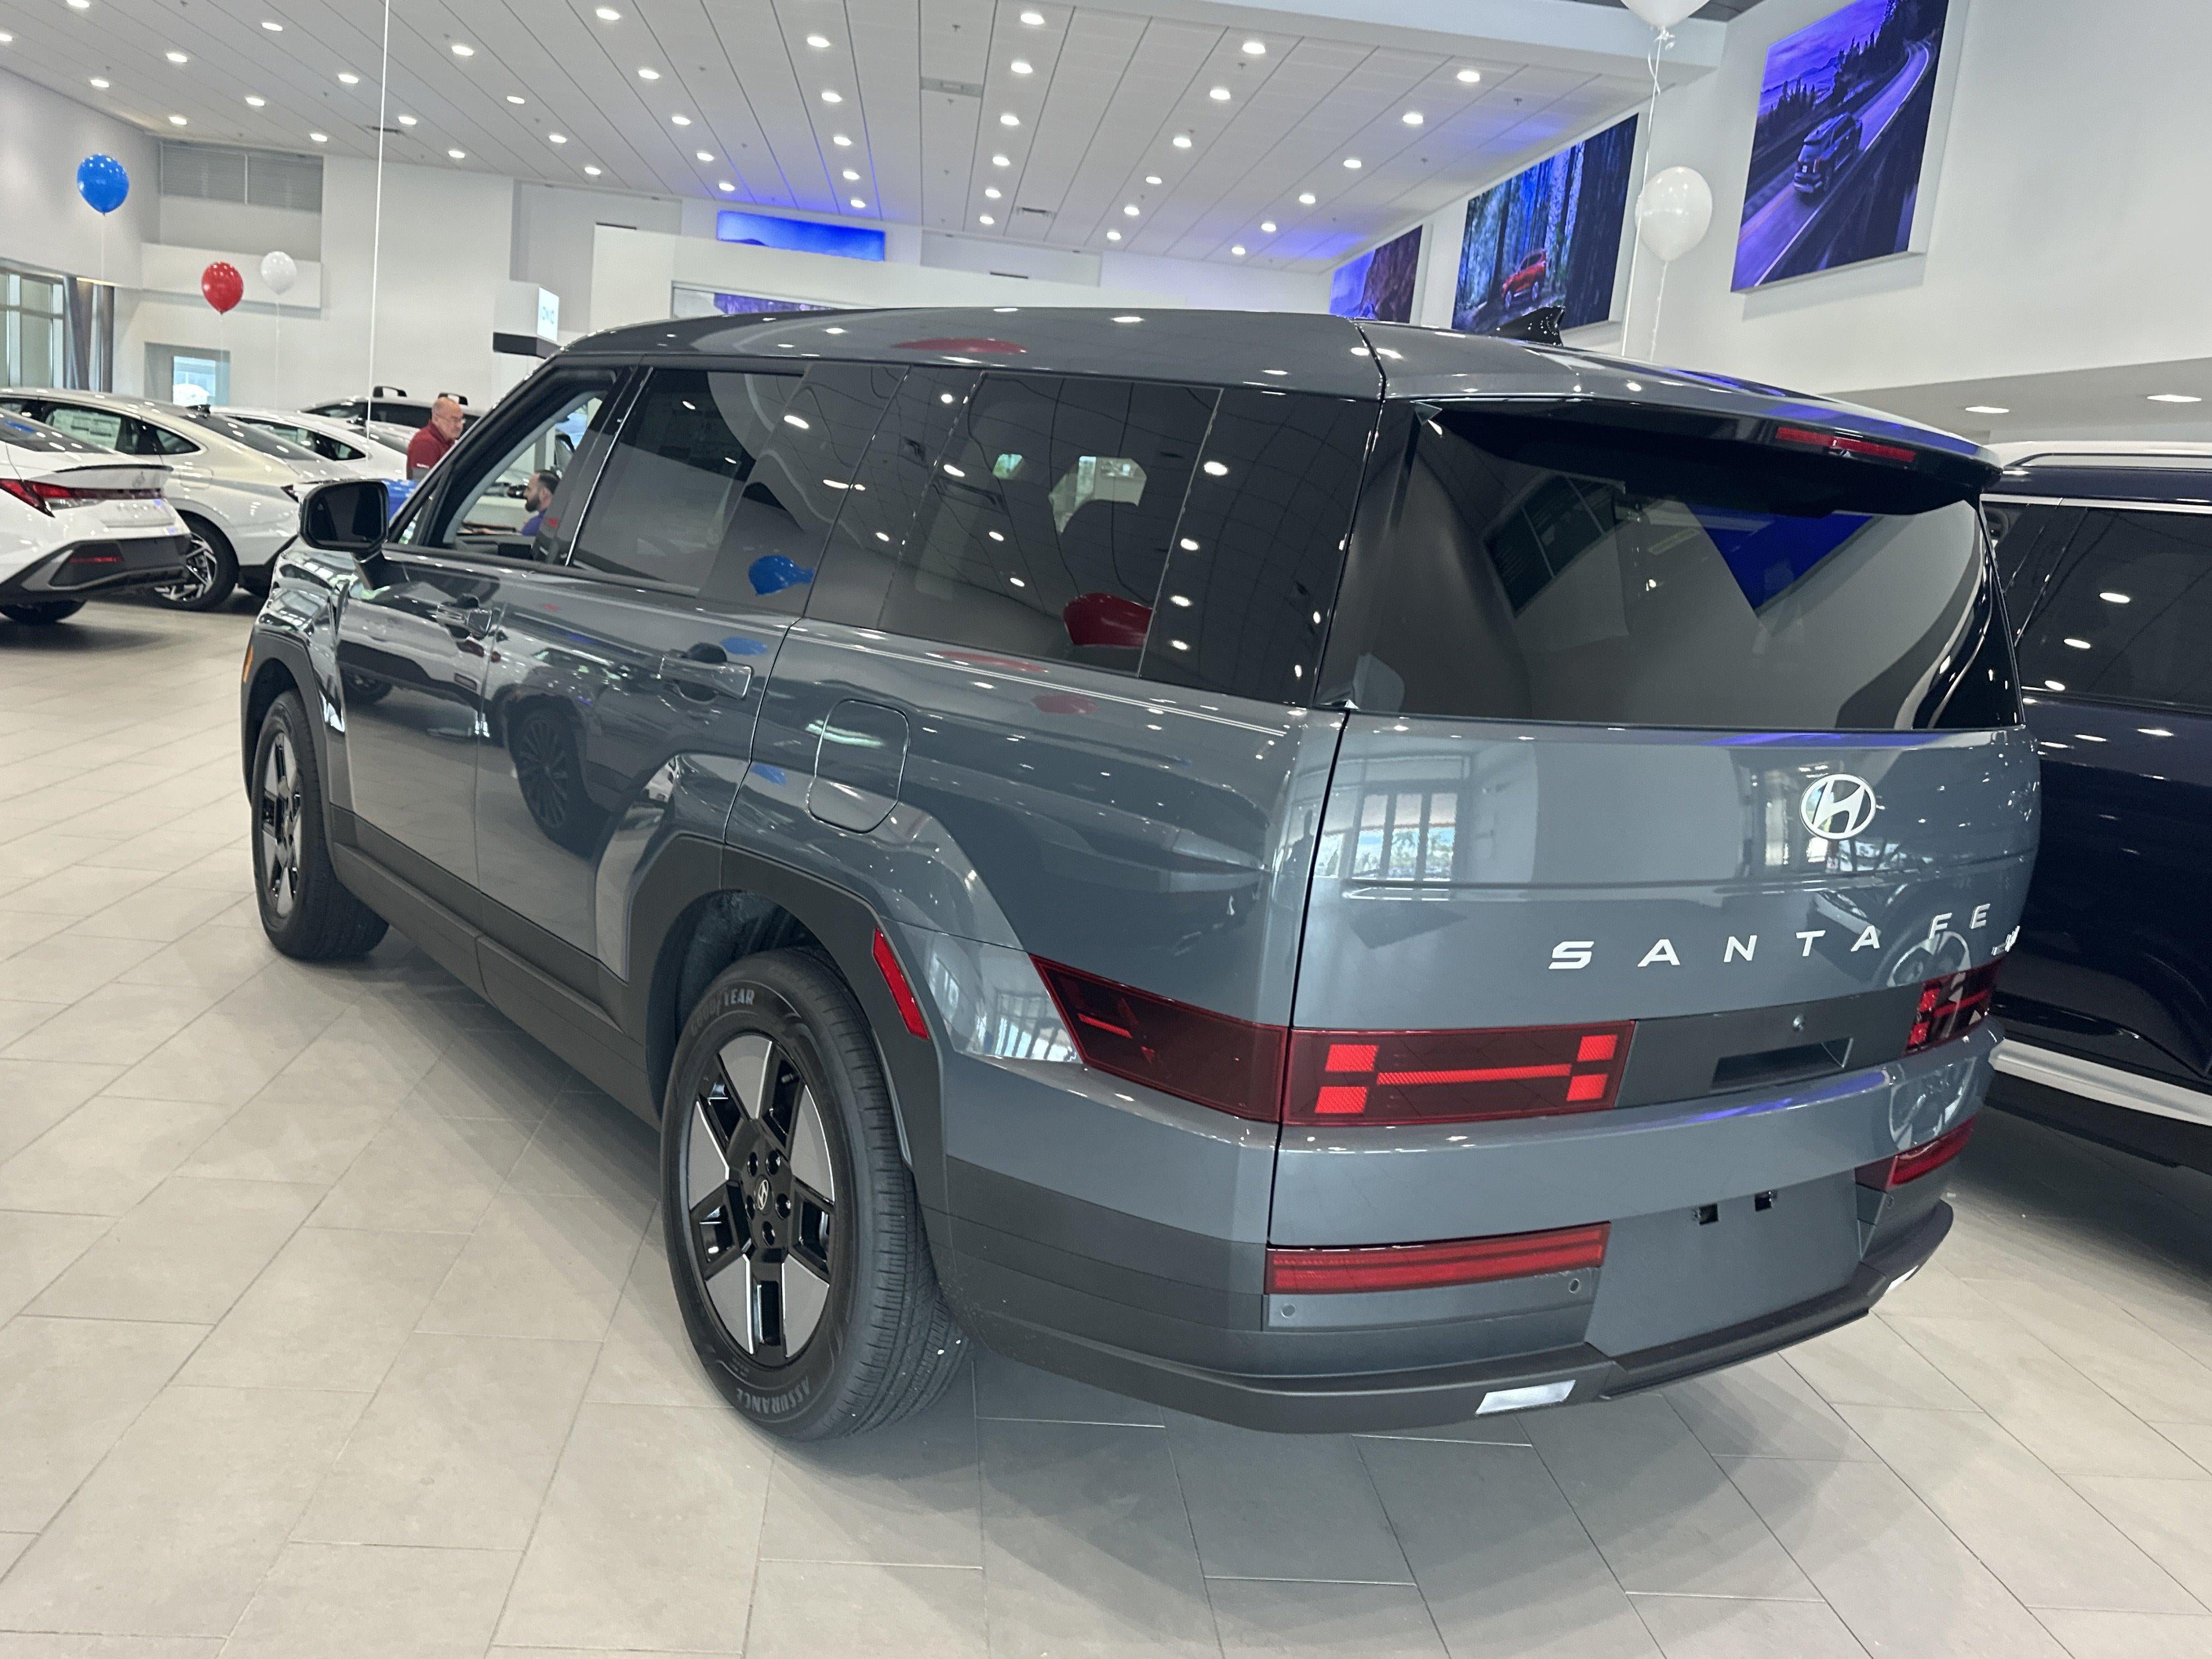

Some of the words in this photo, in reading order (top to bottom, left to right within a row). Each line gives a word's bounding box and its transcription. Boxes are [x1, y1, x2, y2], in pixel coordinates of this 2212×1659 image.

[1548, 925, 1881, 969] SANTA
[1927, 902, 1991, 940] FE
[736, 1375, 811, 1414] ASSURANCE
